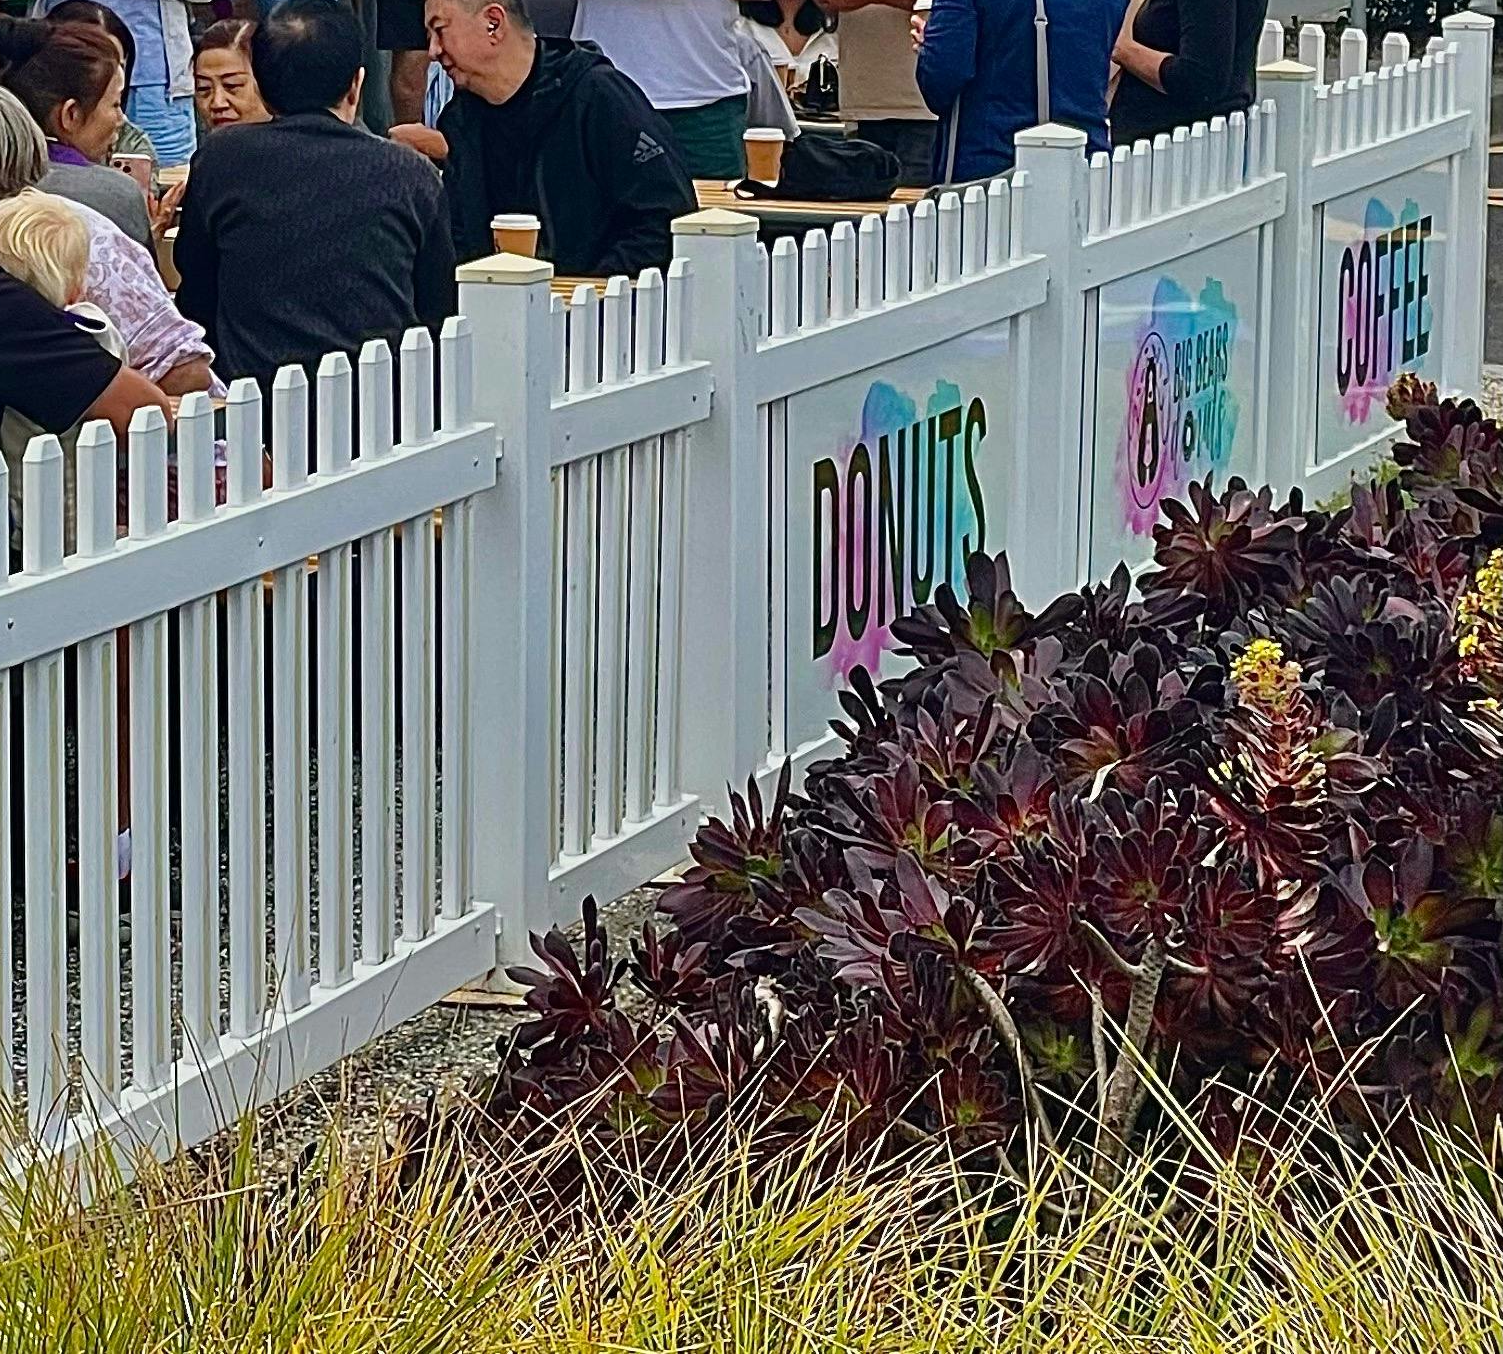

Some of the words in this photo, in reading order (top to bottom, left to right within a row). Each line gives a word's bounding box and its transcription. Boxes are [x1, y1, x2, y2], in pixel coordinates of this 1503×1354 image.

[1173, 337, 1193, 404] BIG
[1195, 321, 1229, 394] BEARS
[1336, 214, 1433, 397] COFFEE
[813, 397, 987, 661] DONUTS
